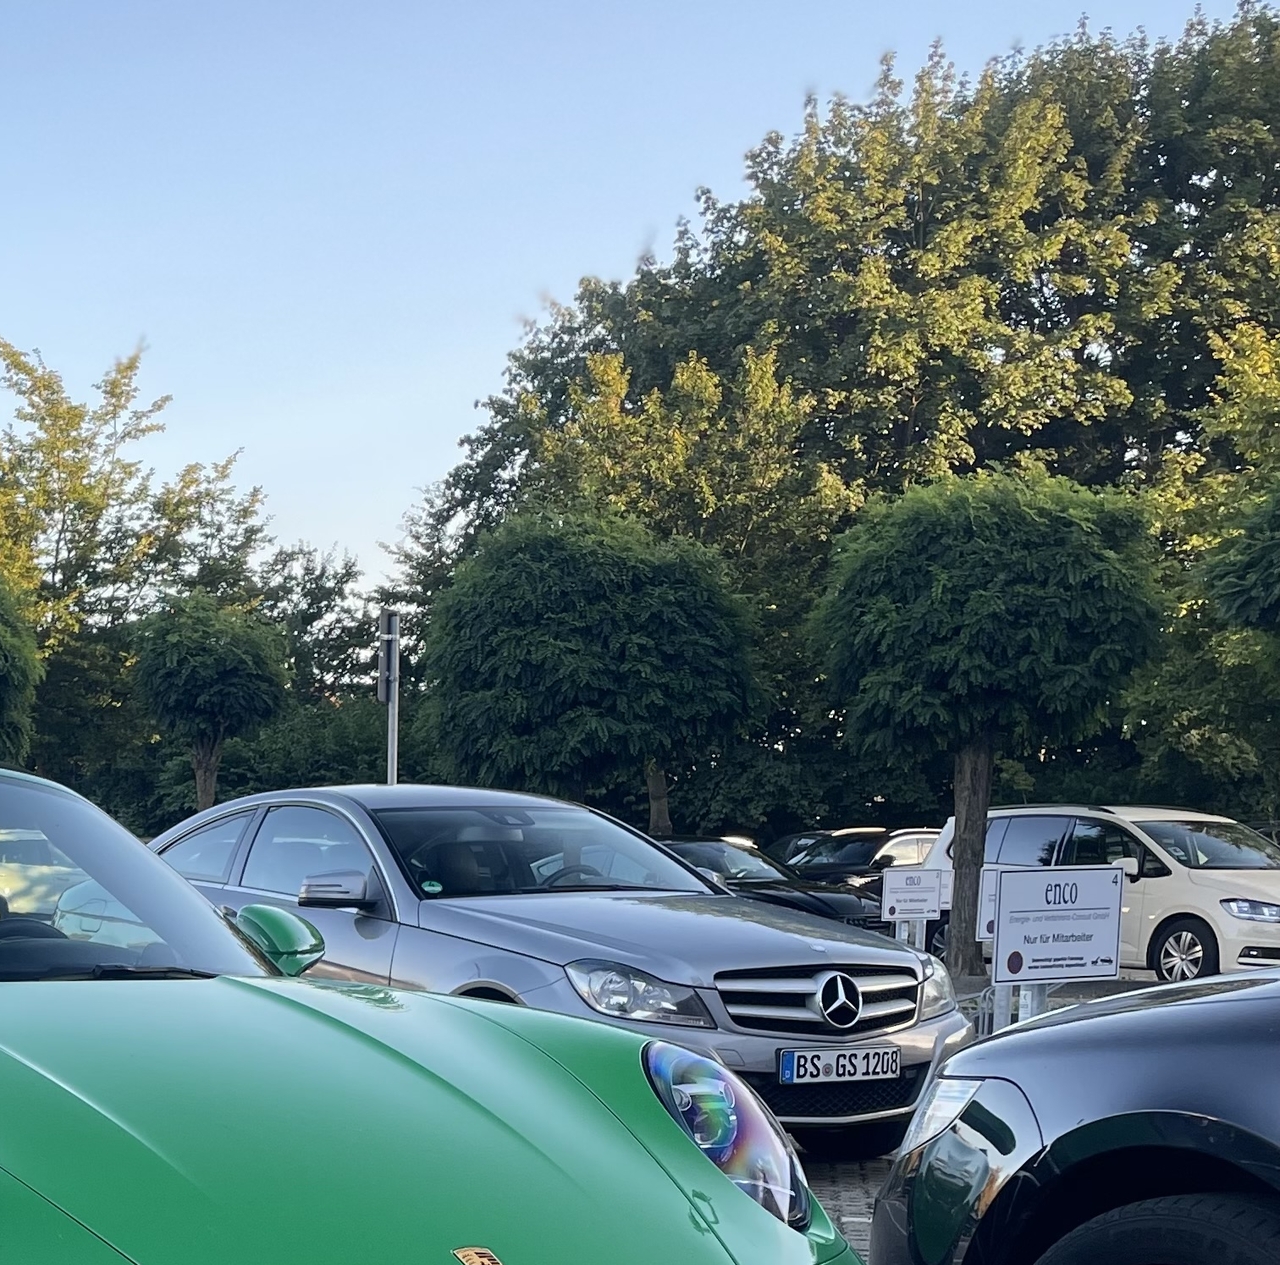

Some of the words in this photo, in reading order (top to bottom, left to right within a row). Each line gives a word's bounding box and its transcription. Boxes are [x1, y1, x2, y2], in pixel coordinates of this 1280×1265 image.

[1112, 874, 1118, 886] 4
[1045, 882, 1078, 905] enco
[1023, 935, 1038, 944] Nur
[1040, 934, 1050, 943] für
[1052, 932, 1094, 943] Mitarbeiter
[796, 1054, 821, 1079] BS
[836, 1053, 858, 1078] GS
[861, 1050, 898, 1076] 1208
